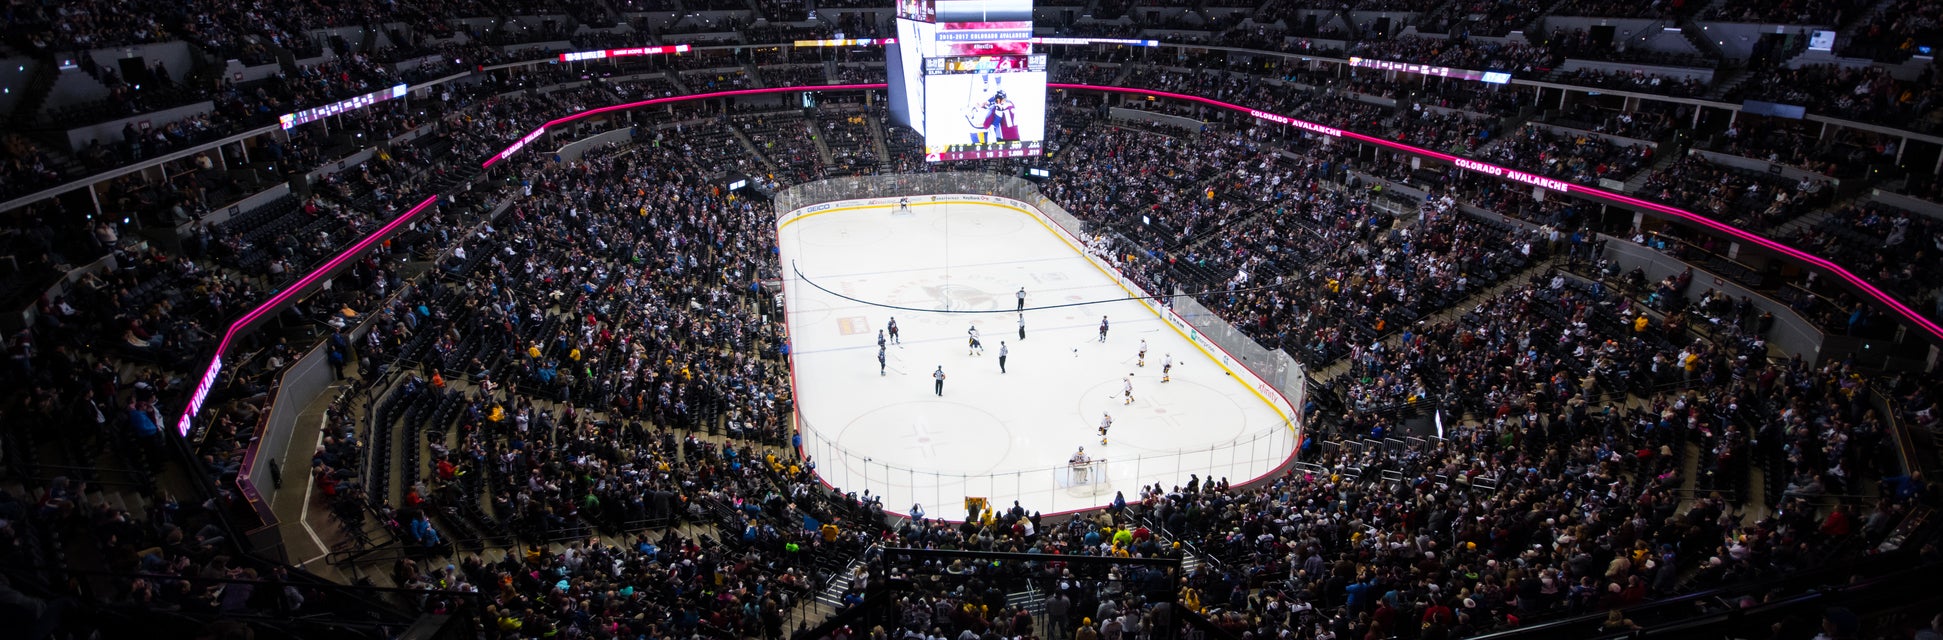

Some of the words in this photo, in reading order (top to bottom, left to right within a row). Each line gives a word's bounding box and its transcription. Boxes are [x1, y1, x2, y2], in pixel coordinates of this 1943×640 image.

[1250, 110, 1288, 124] COLORADO
[1292, 120, 1342, 137] AVALANCHE
[502, 140, 524, 159] COLORADO
[1455, 159, 1502, 175] COLORADO
[1506, 170, 1568, 192] AVALANCHE
[807, 204, 830, 212] GEICO
[180, 414, 190, 437] DO
[192, 354, 222, 416] AVALANCHE
[1257, 382, 1278, 403] xfinity
